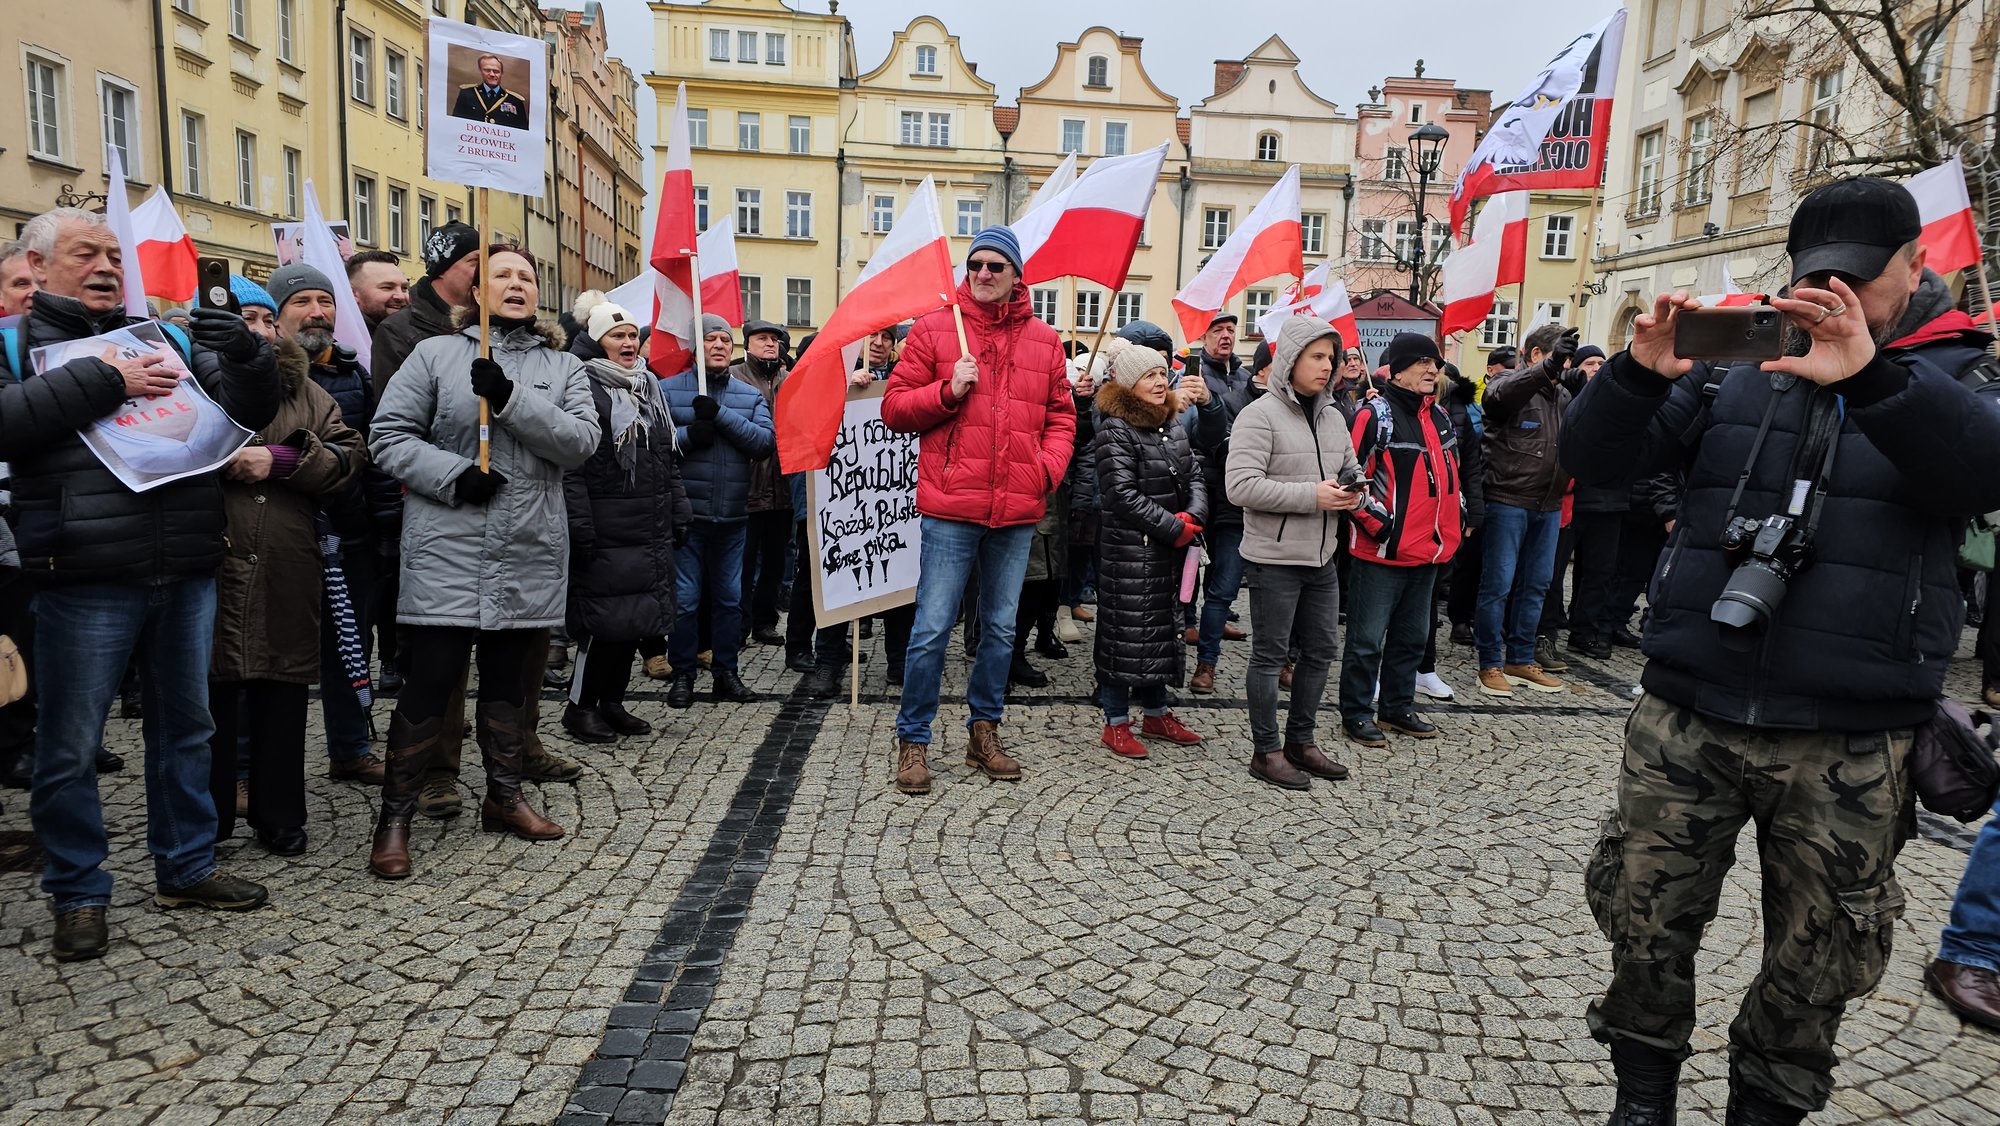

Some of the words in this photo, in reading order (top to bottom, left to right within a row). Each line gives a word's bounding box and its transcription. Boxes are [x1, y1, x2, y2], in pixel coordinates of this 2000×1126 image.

[466, 123, 511, 138] DONALD
[460, 134, 516, 151] CZŁOWIEK
[458, 145, 465, 154] Z
[468, 148, 517, 162] BRUKSELI
[1377, 302, 1395, 311] MK
[1357, 328, 1402, 337] MUZEUM
[1360, 338, 1391, 348] rkon
[115, 401, 192, 427] MIAŁ
[834, 411, 859, 467] dy
[819, 501, 875, 550] Każde
